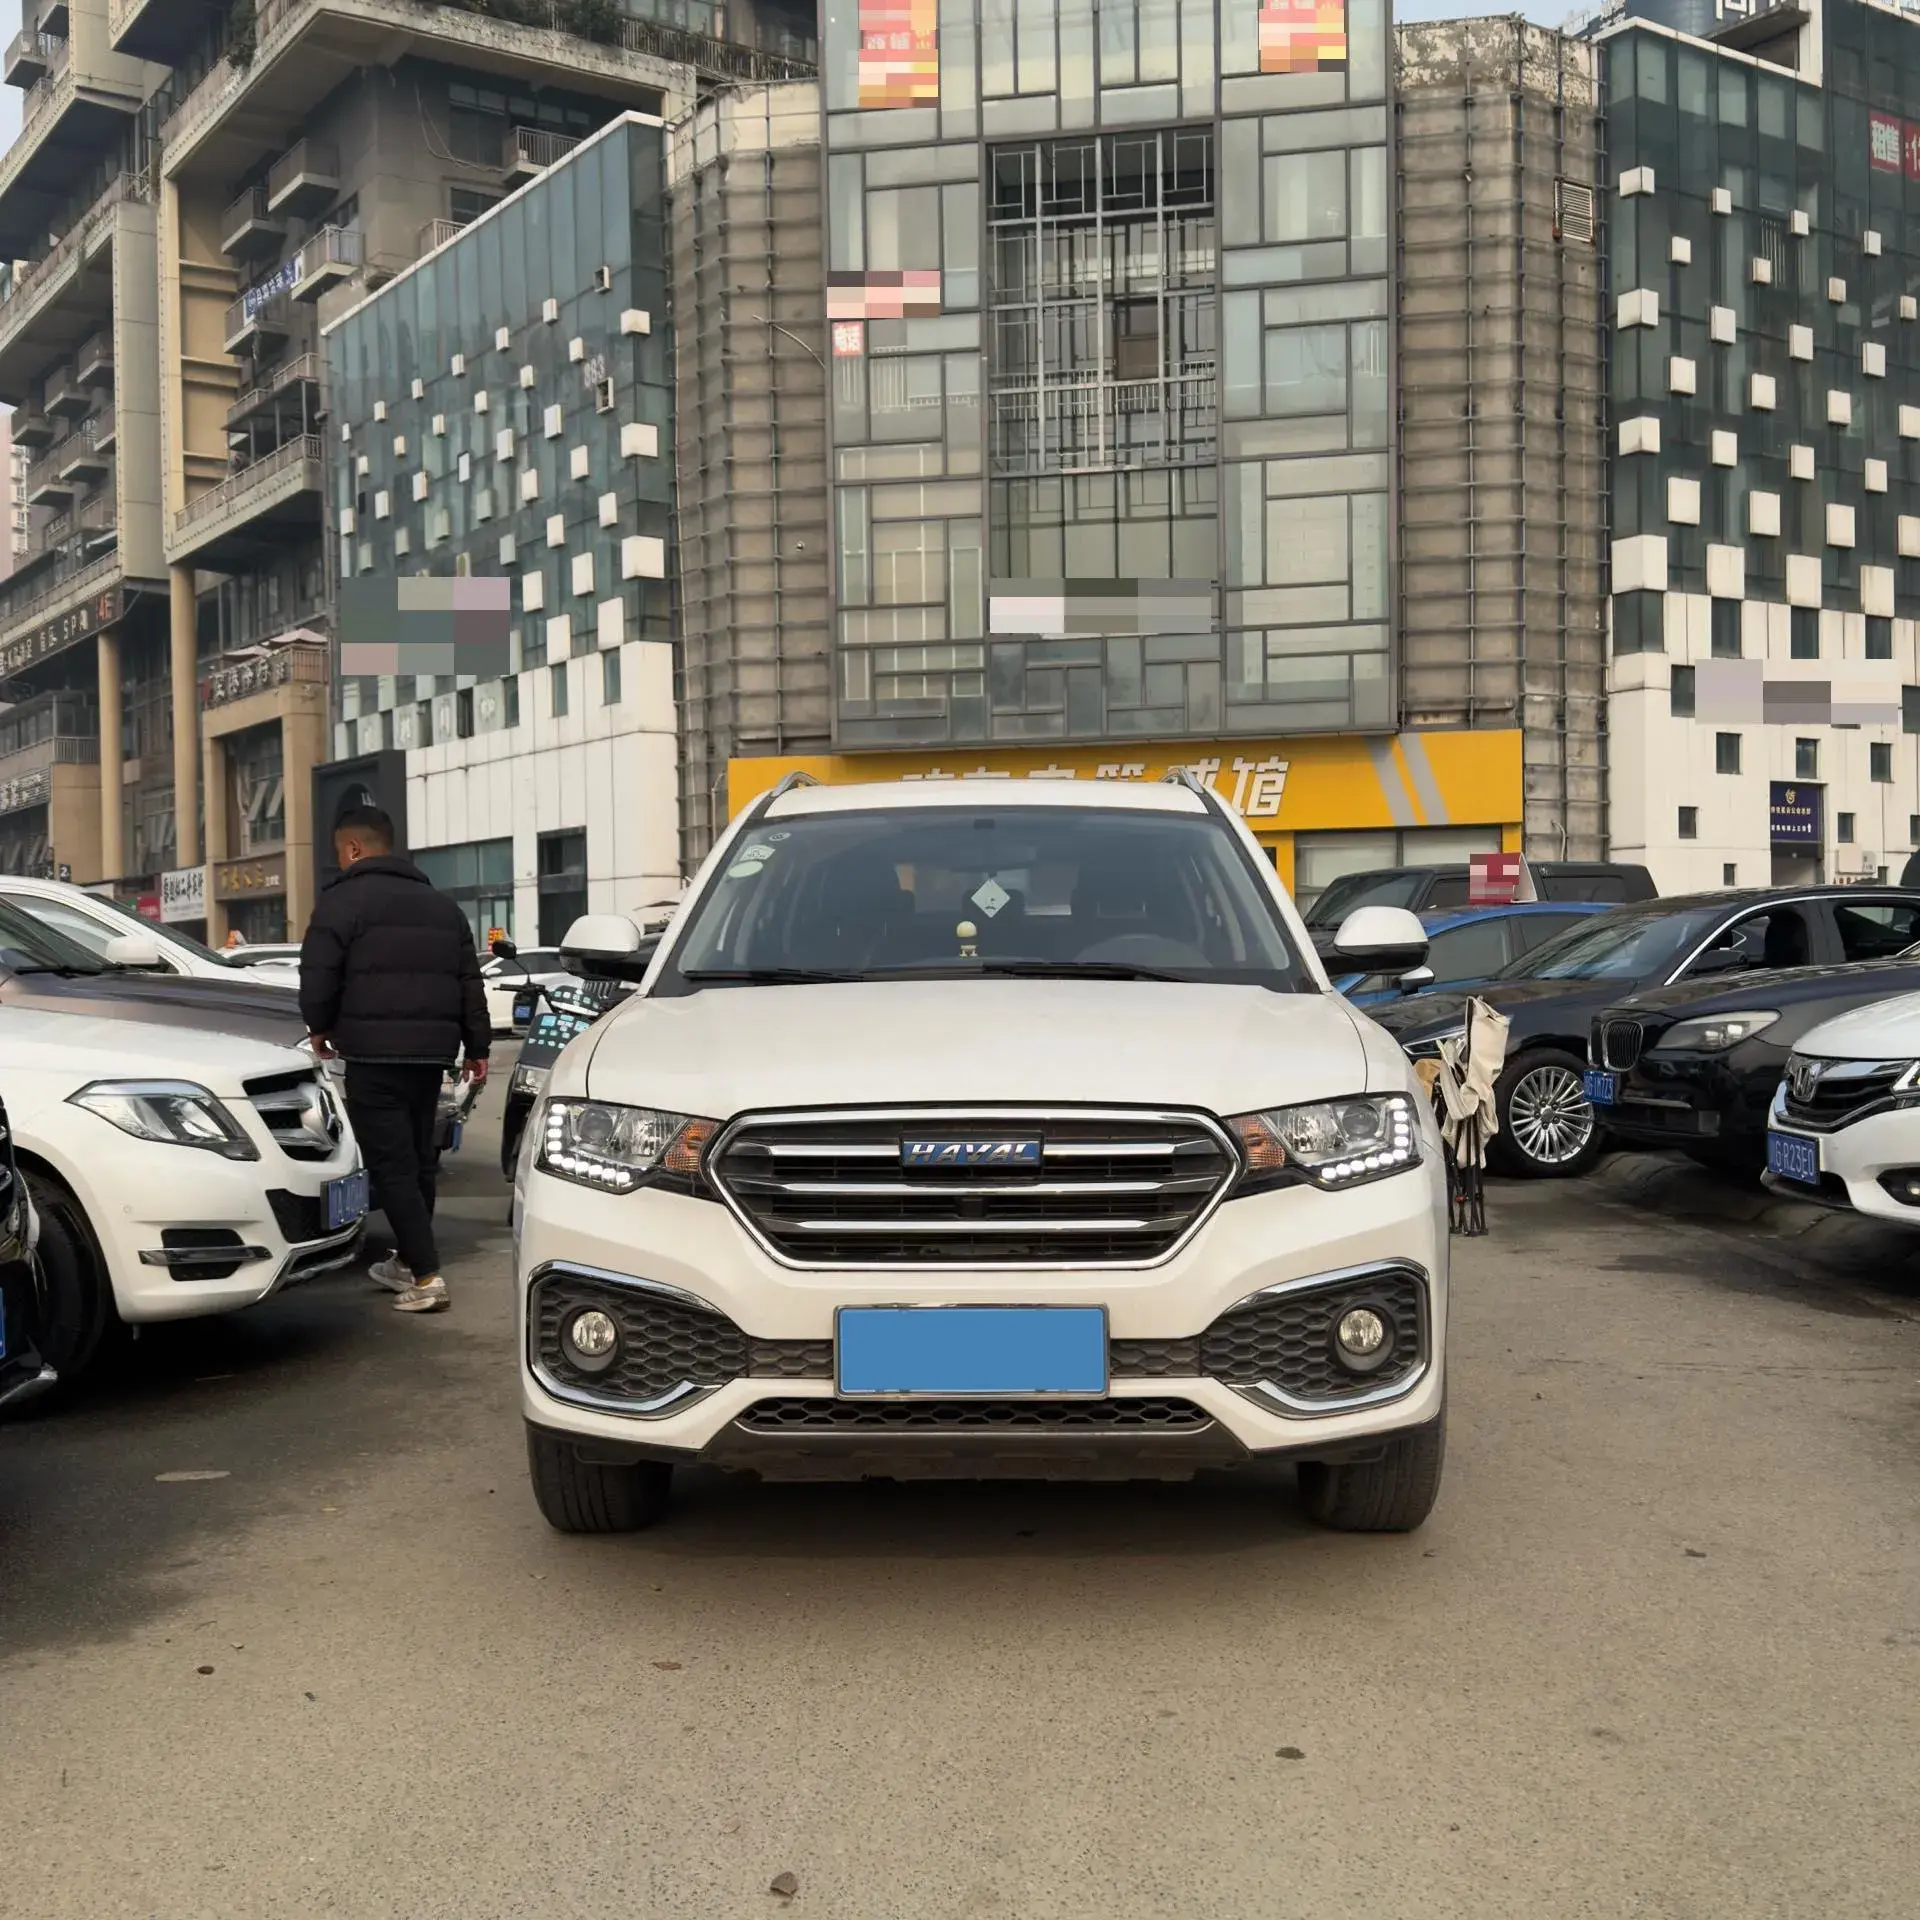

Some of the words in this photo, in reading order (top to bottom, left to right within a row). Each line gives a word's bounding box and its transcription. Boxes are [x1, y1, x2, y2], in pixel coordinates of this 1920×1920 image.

[1870, 120, 1900, 166] 租售
[63, 608, 89, 640] SPA
[908, 1144, 1036, 1162] HAVAL
